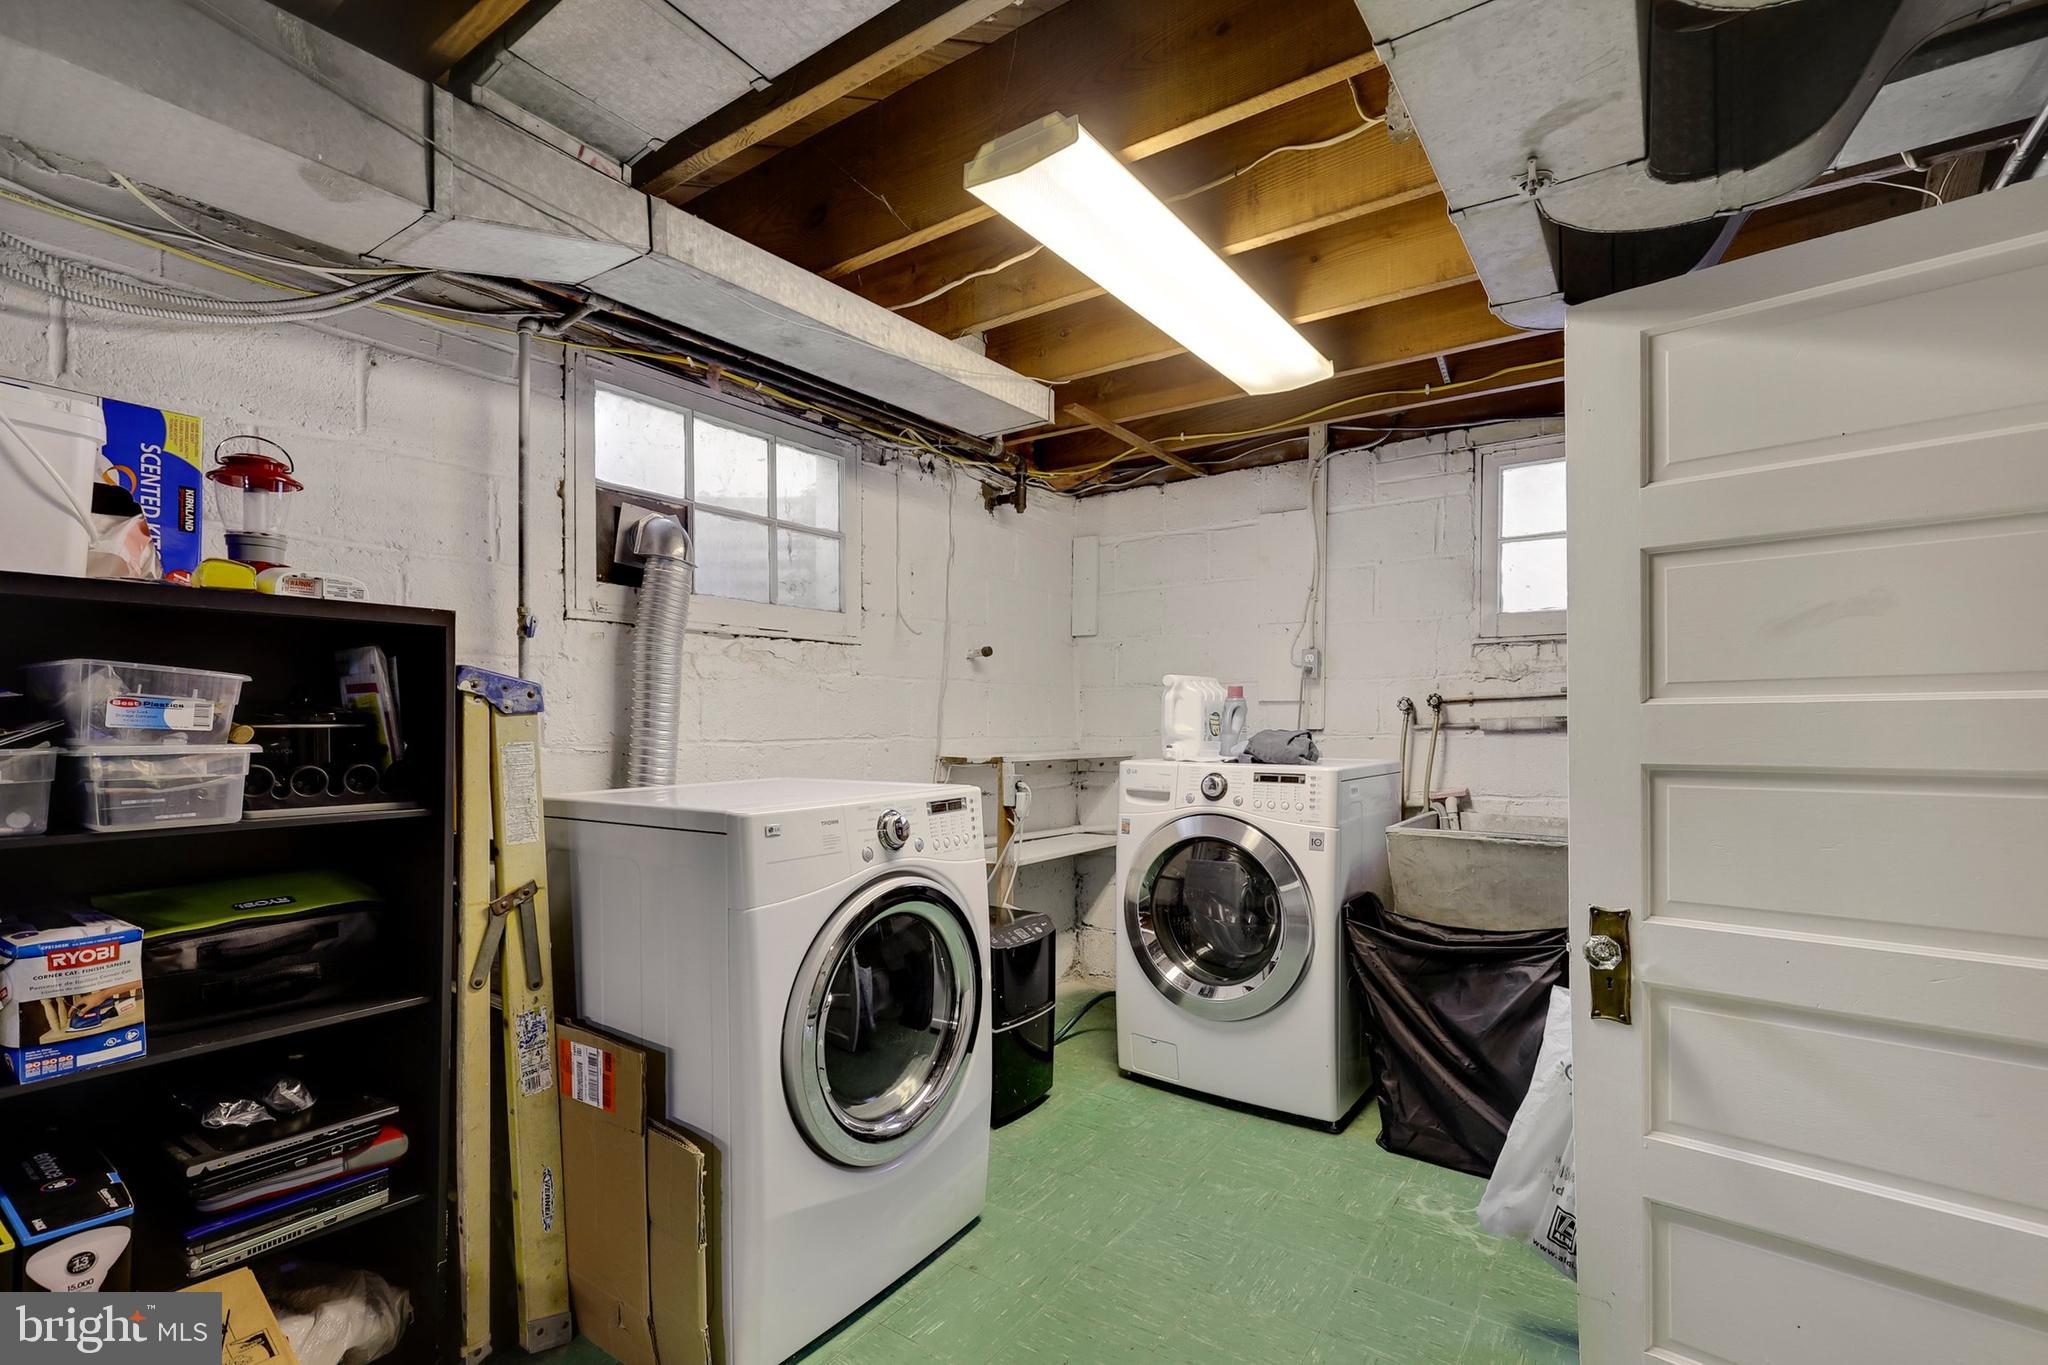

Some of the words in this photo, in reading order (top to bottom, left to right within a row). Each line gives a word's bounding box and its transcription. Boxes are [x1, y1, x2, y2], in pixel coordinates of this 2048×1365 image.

[140, 442, 162, 515] SCENTED
[184, 488, 195, 532] KIRKLAND
[51, 945, 115, 967] RYOBI
[33, 972, 63, 981] CORNER
[82, 966, 105, 974] FINISH
[106, 960, 131, 969] SANDER
[72, 1256, 90, 1268] 13
